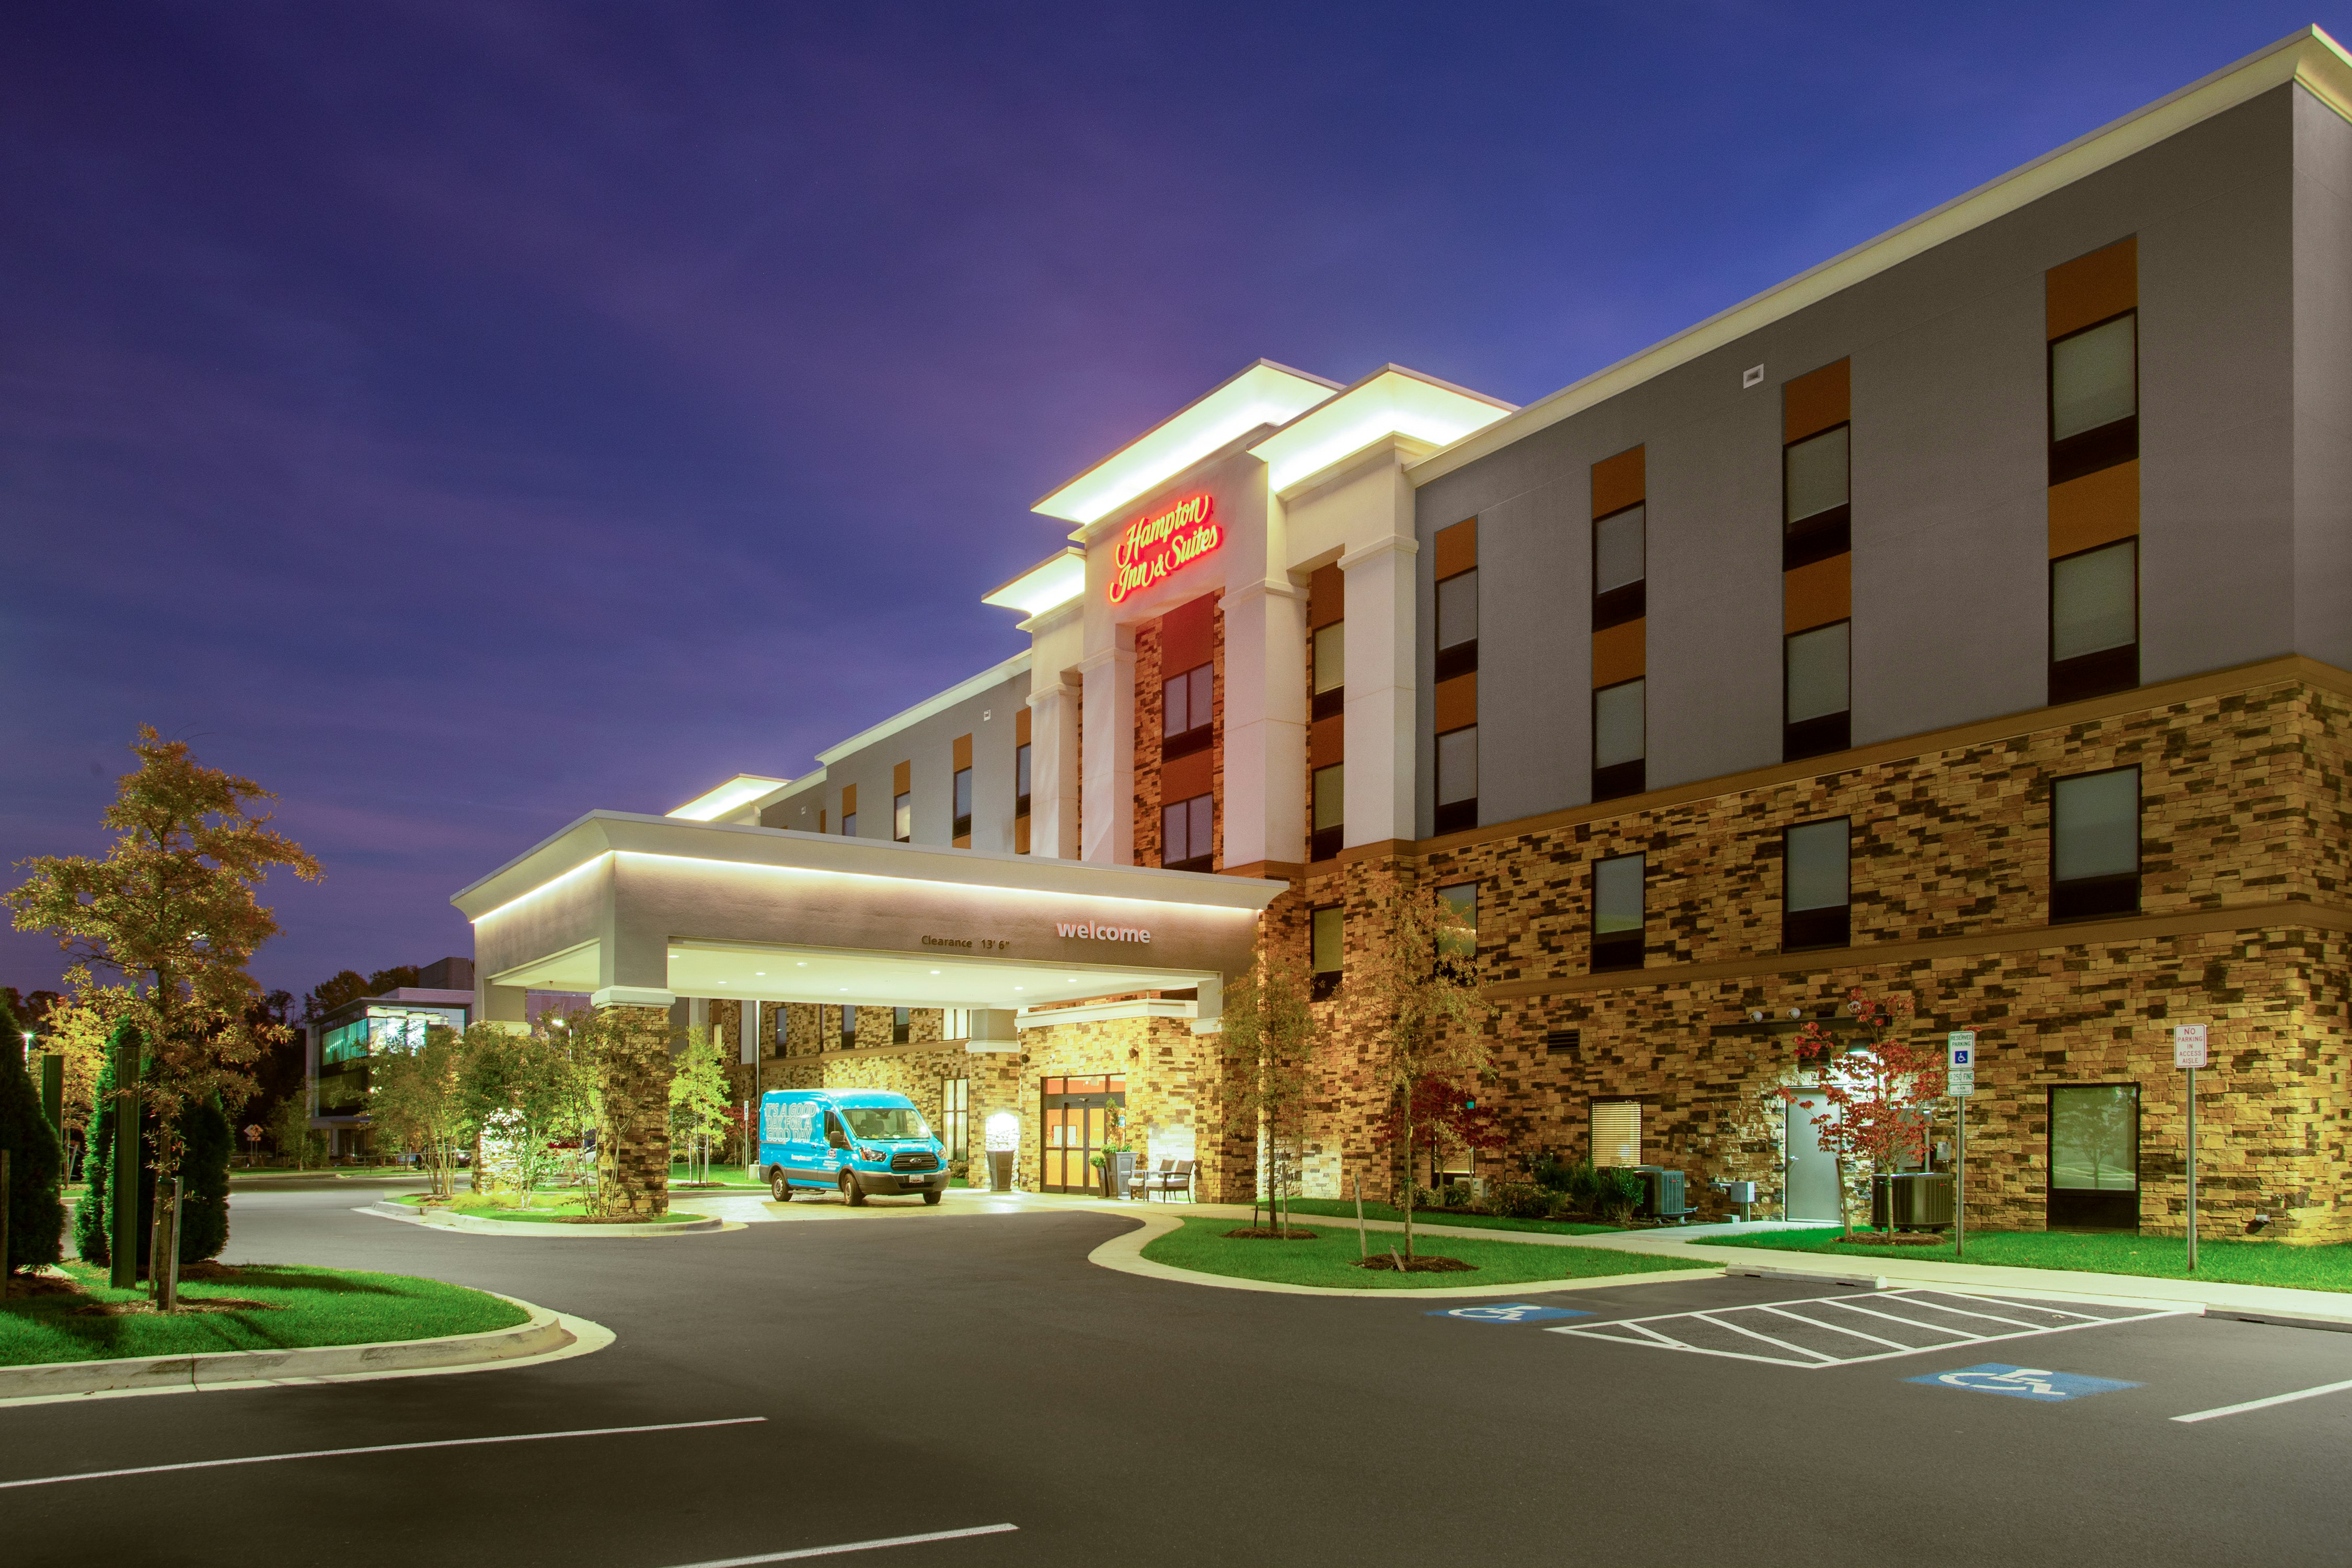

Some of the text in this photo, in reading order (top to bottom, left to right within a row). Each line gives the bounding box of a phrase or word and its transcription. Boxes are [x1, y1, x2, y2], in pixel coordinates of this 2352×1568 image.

[1115, 495, 1209, 568] Hampton
[1110, 525, 1218, 602] Inn & Suites
[1056, 920, 1151, 943] welcome
[921, 935, 1010, 950] Clearance 13' 6"
[765, 1103, 779, 1116] IT'S
[780, 1103, 787, 1116] A
[789, 1103, 817, 1117] GOOD
[766, 1115, 812, 1130] DAY FOR A
[766, 1128, 812, 1143] GOOD DAY
